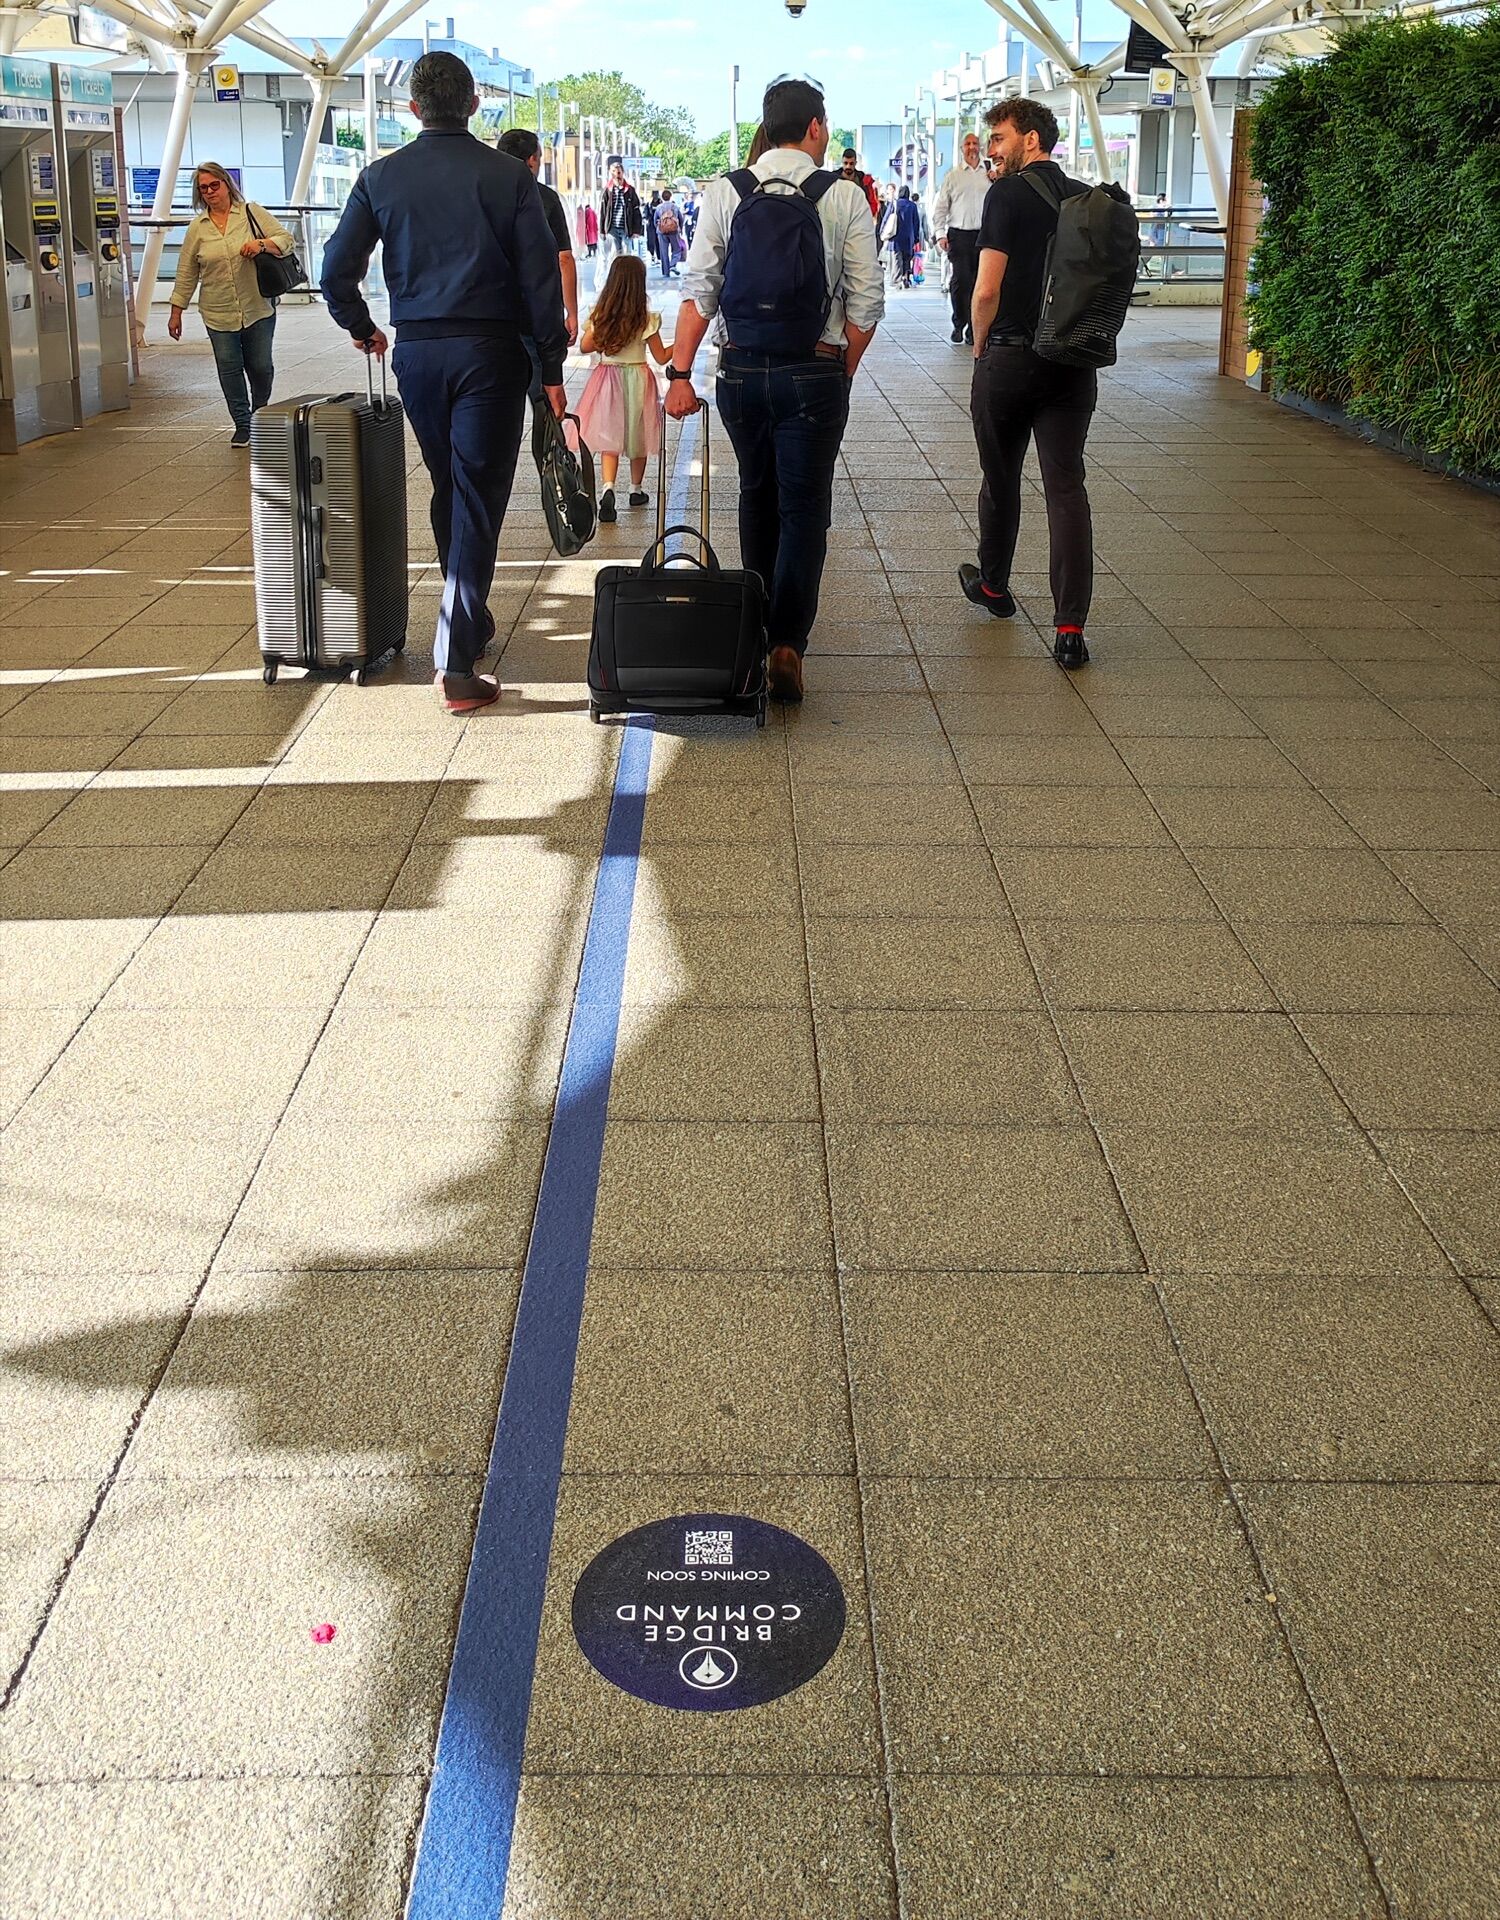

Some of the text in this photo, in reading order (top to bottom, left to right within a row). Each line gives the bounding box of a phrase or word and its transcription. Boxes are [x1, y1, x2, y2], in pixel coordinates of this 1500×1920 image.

[12, 68, 42, 88] Tickets
[79, 76, 105, 96] Tickets
[647, 1570, 771, 1581] COMING SOON
[616, 1604, 802, 1622] COMMAND
[644, 1624, 773, 1642] BRIDGE
